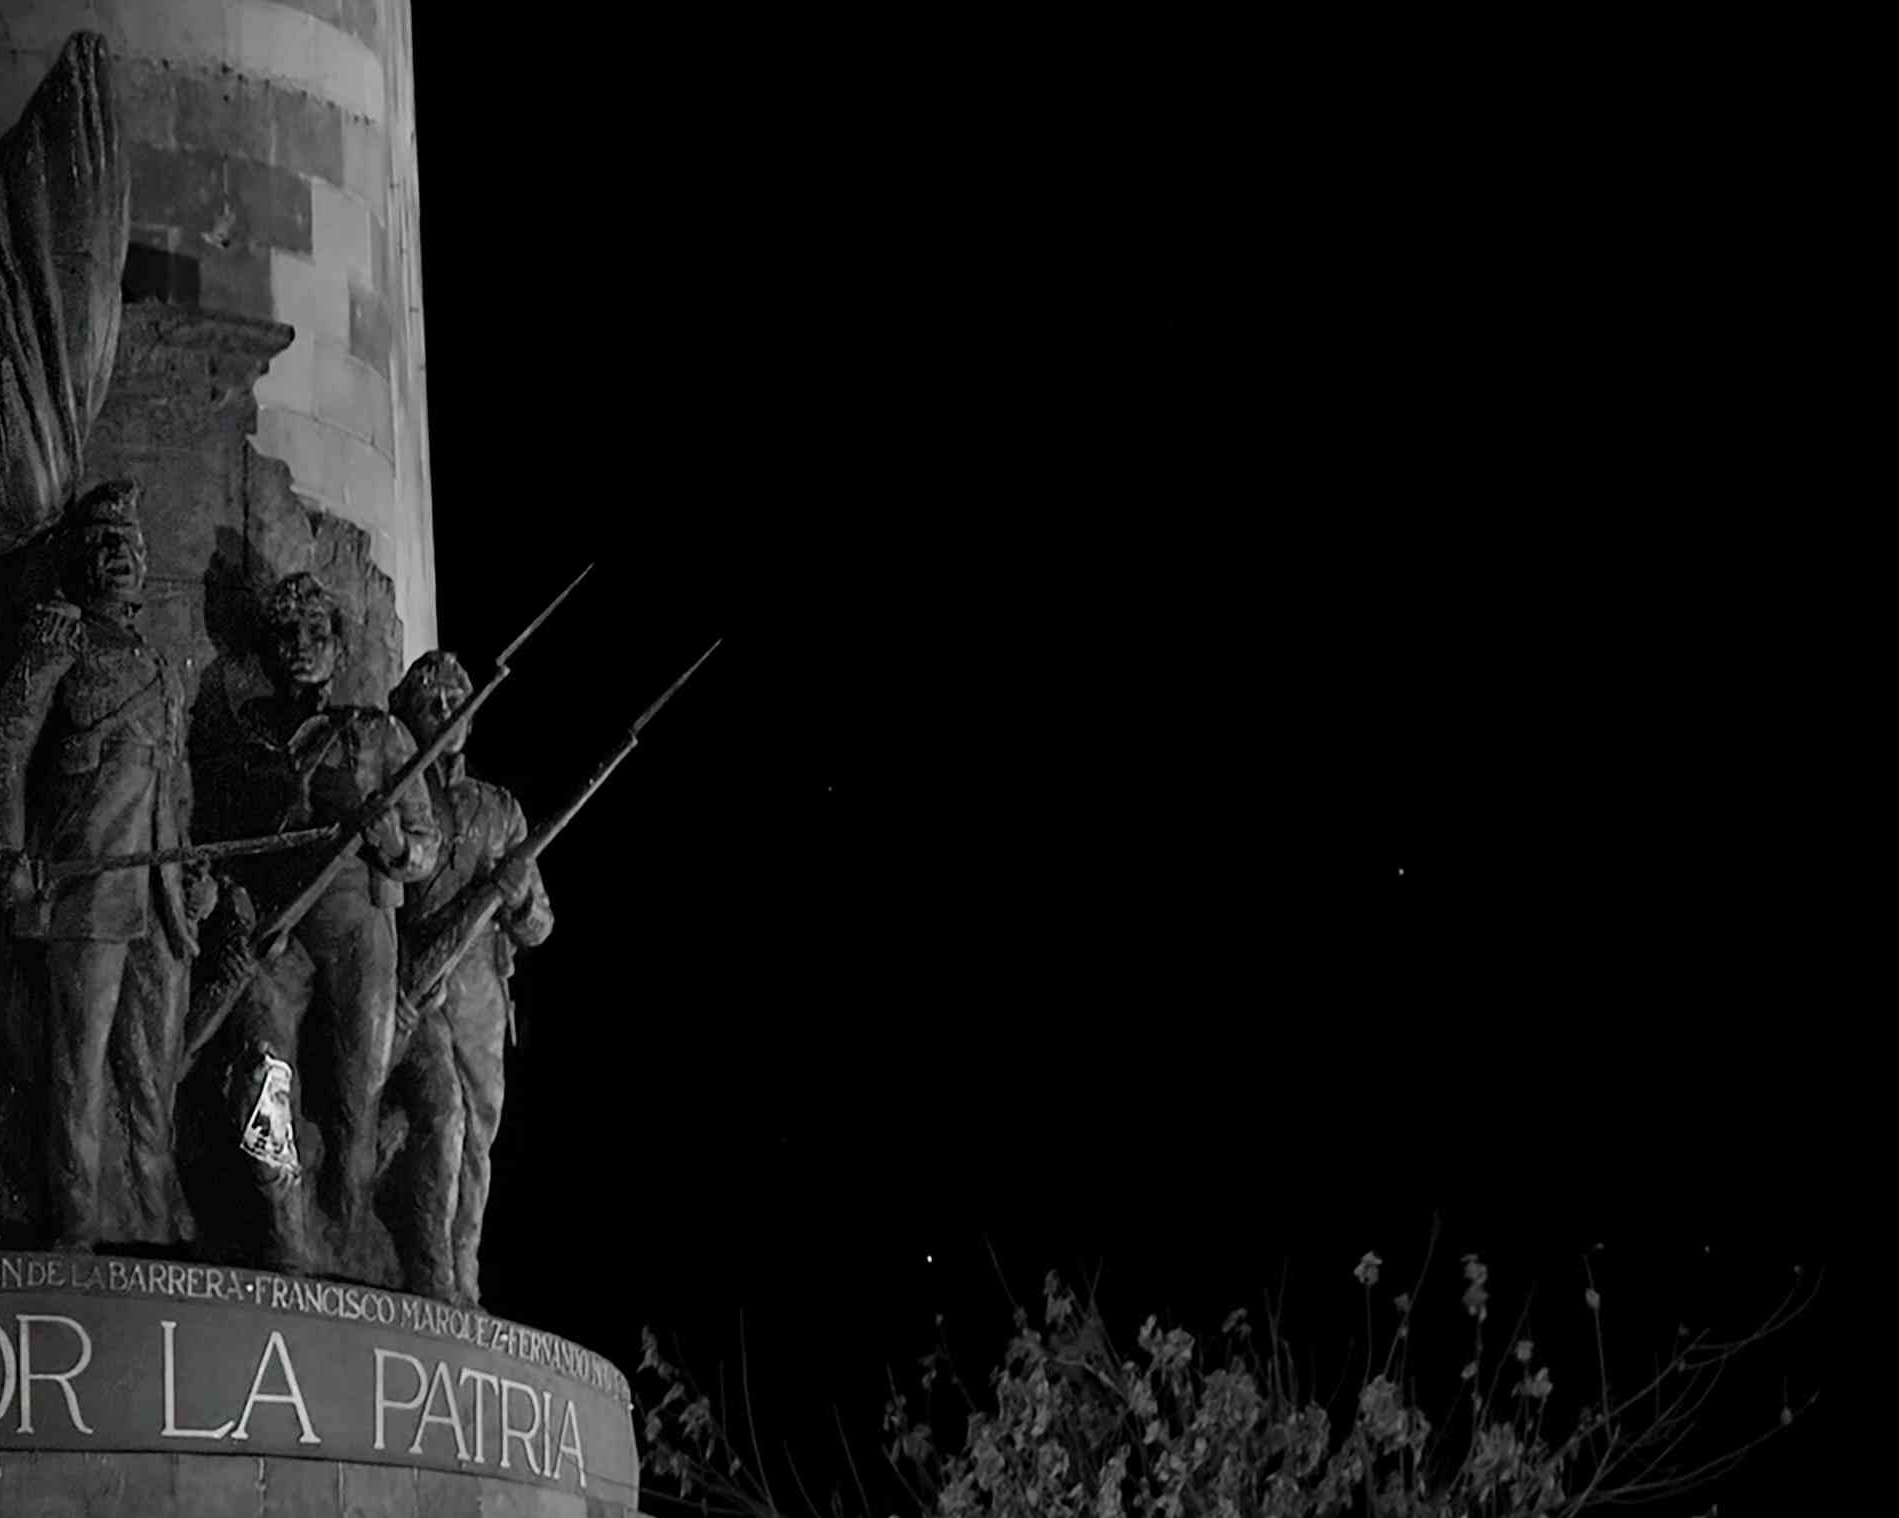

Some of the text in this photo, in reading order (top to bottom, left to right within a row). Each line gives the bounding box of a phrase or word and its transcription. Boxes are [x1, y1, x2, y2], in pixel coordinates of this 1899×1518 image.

[26, 1259, 66, 1288] DE
[70, 1262, 106, 1289] LA
[108, 1260, 245, 1301] BARRERA
[254, 1275, 396, 1324] FRANCISCO
[160, 1318, 323, 1447] LA
[372, 1347, 589, 1489] PATRIA
